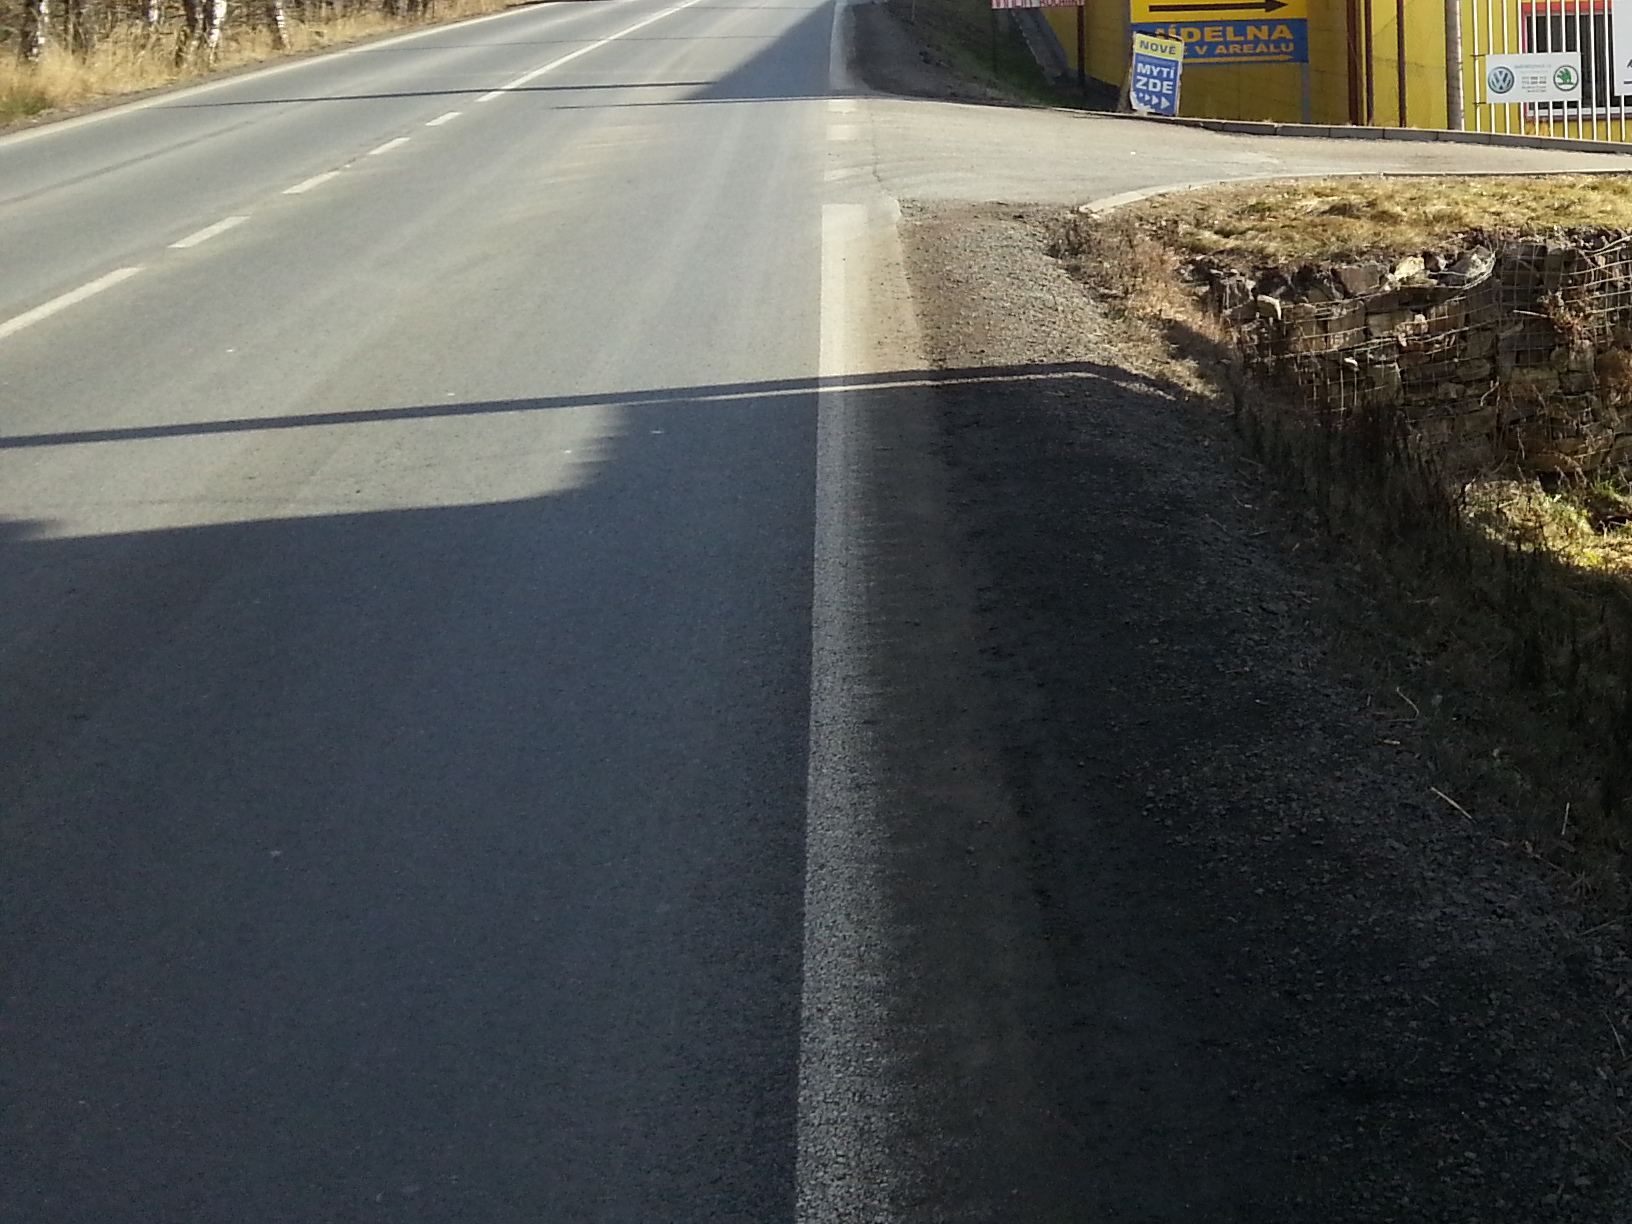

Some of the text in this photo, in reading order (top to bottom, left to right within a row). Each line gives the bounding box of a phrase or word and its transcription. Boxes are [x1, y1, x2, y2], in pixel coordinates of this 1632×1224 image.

[1195, 45, 1207, 55] V
[1136, 62, 1175, 79] MYTÍ
[1136, 75, 1174, 94] ZDE
